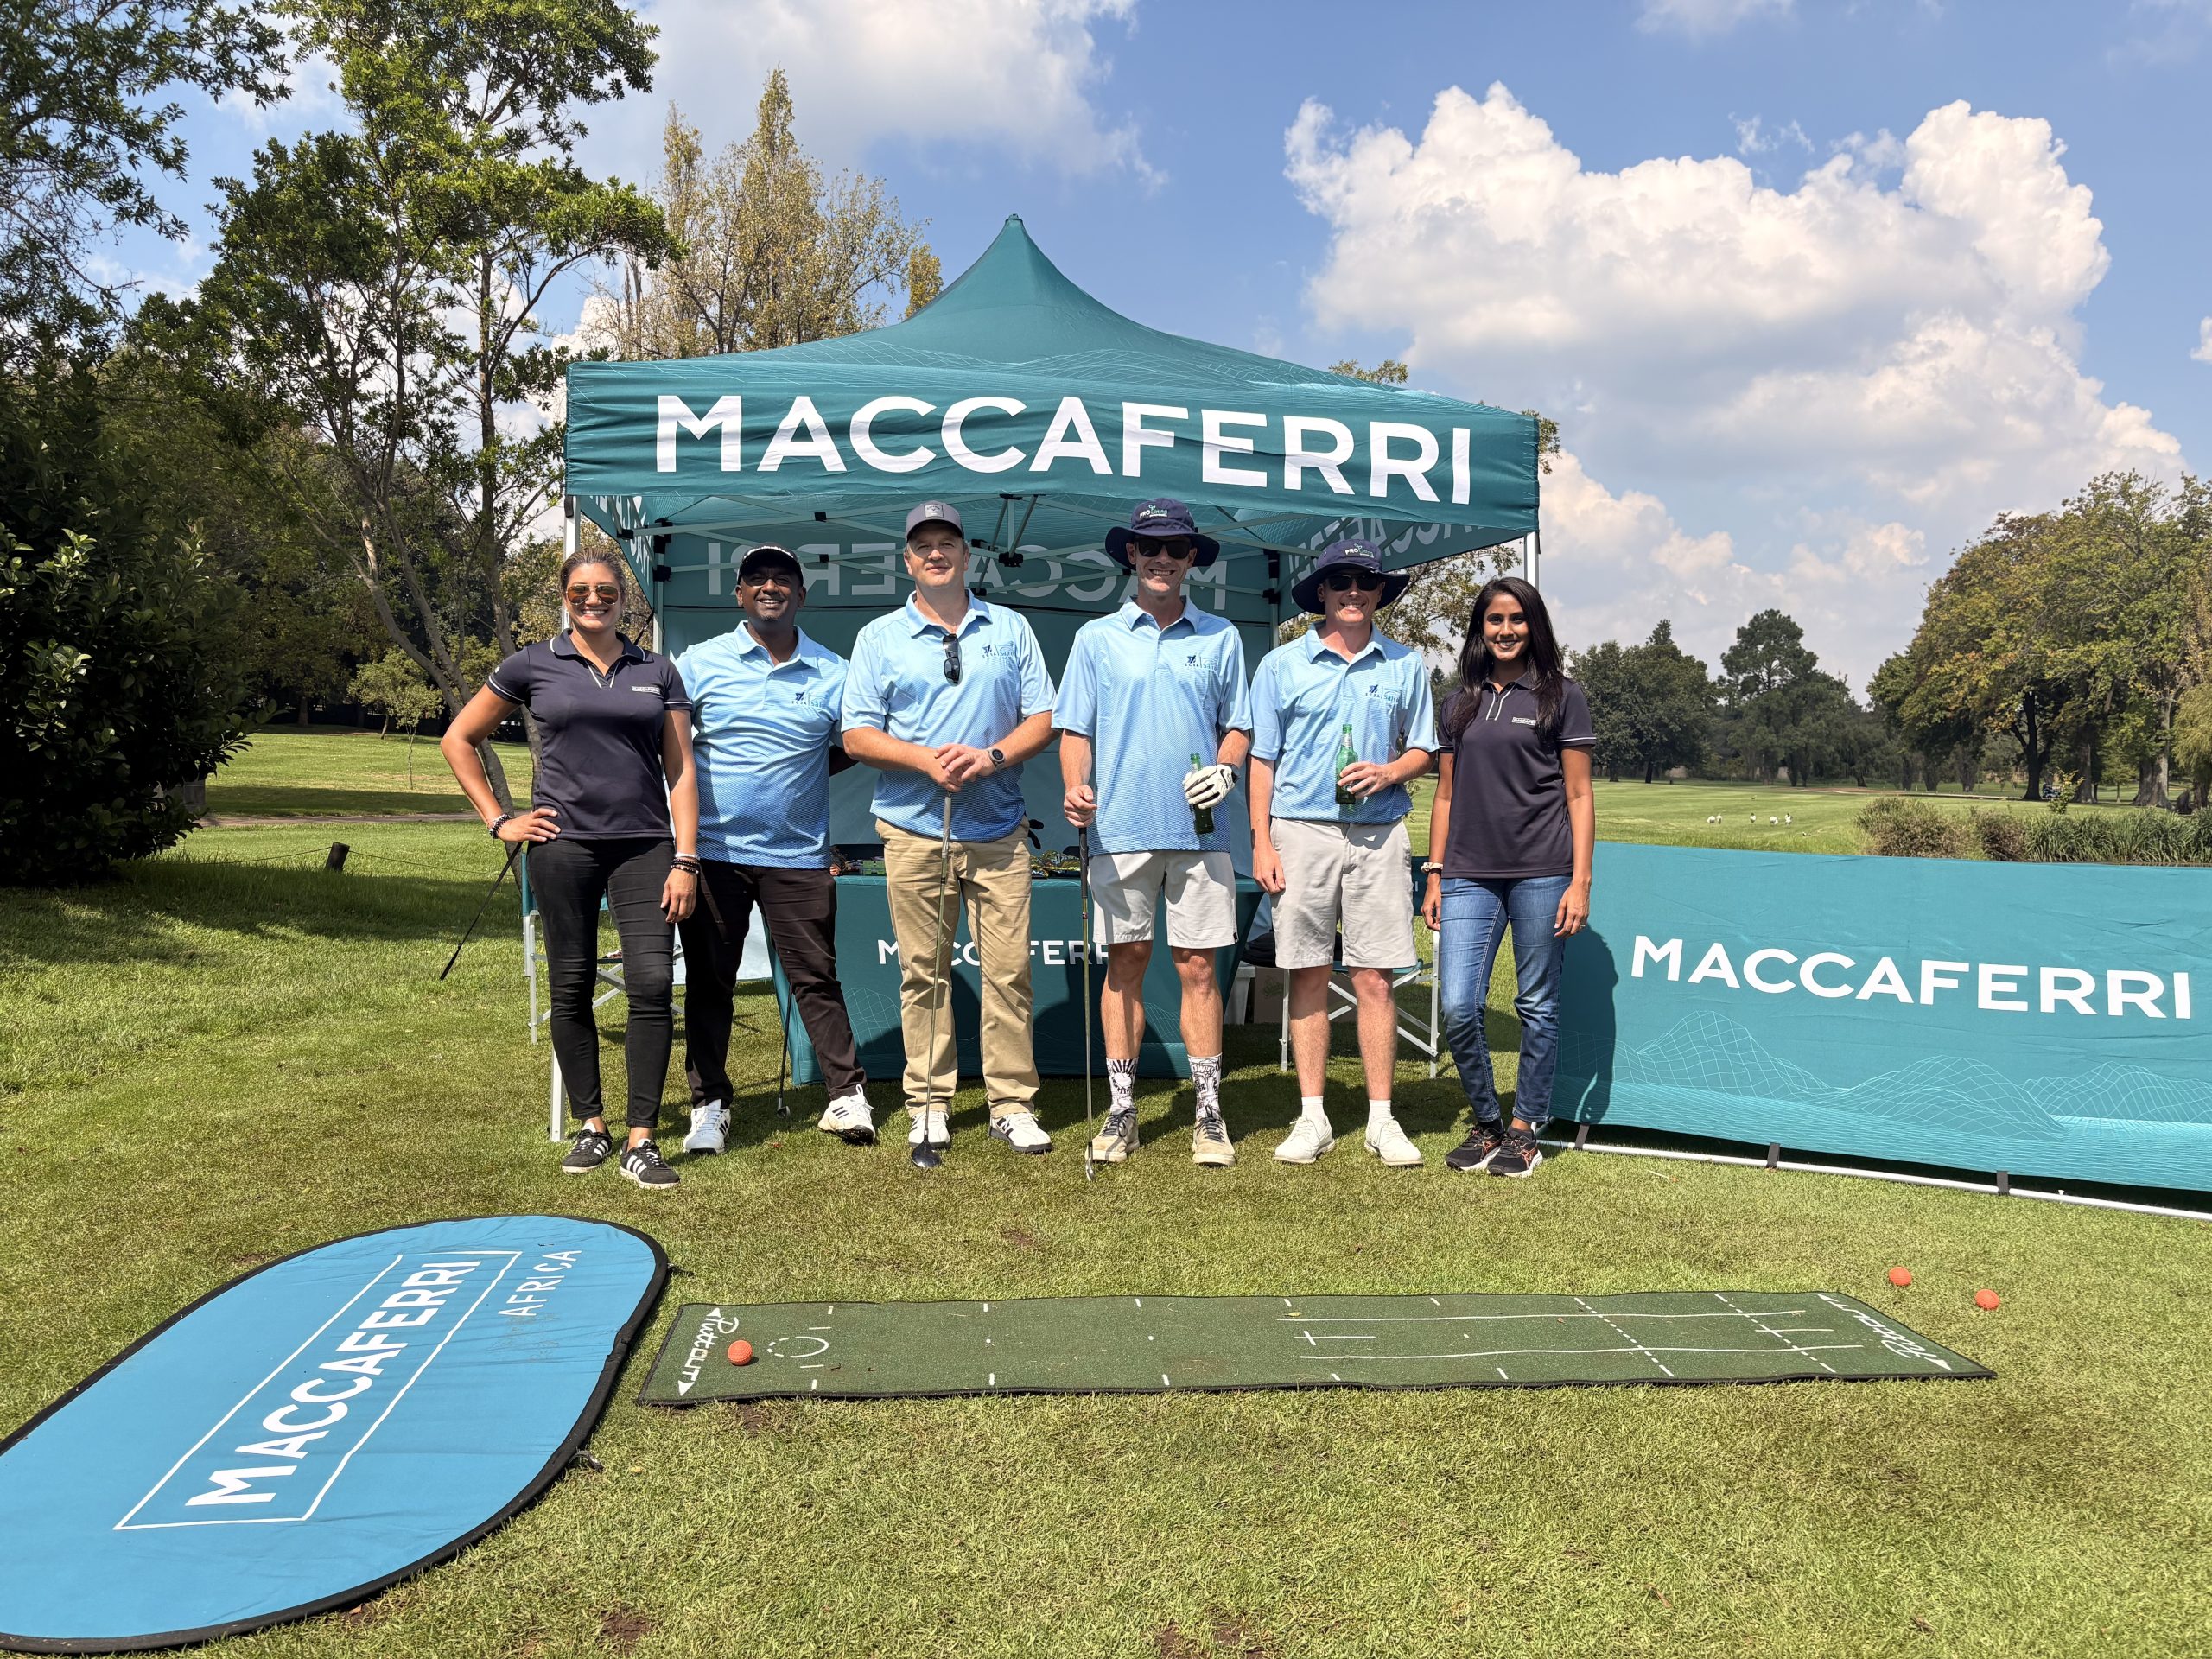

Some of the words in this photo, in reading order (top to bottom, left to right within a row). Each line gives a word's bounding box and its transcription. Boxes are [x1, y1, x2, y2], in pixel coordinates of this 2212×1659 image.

[655, 395, 1471, 505] MACCAFERRI
[1631, 935, 2192, 1020] MACCAFERRI
[498, 1249, 582, 1317] AFRICA
[185, 1260, 482, 1507] MACCAFERRI
